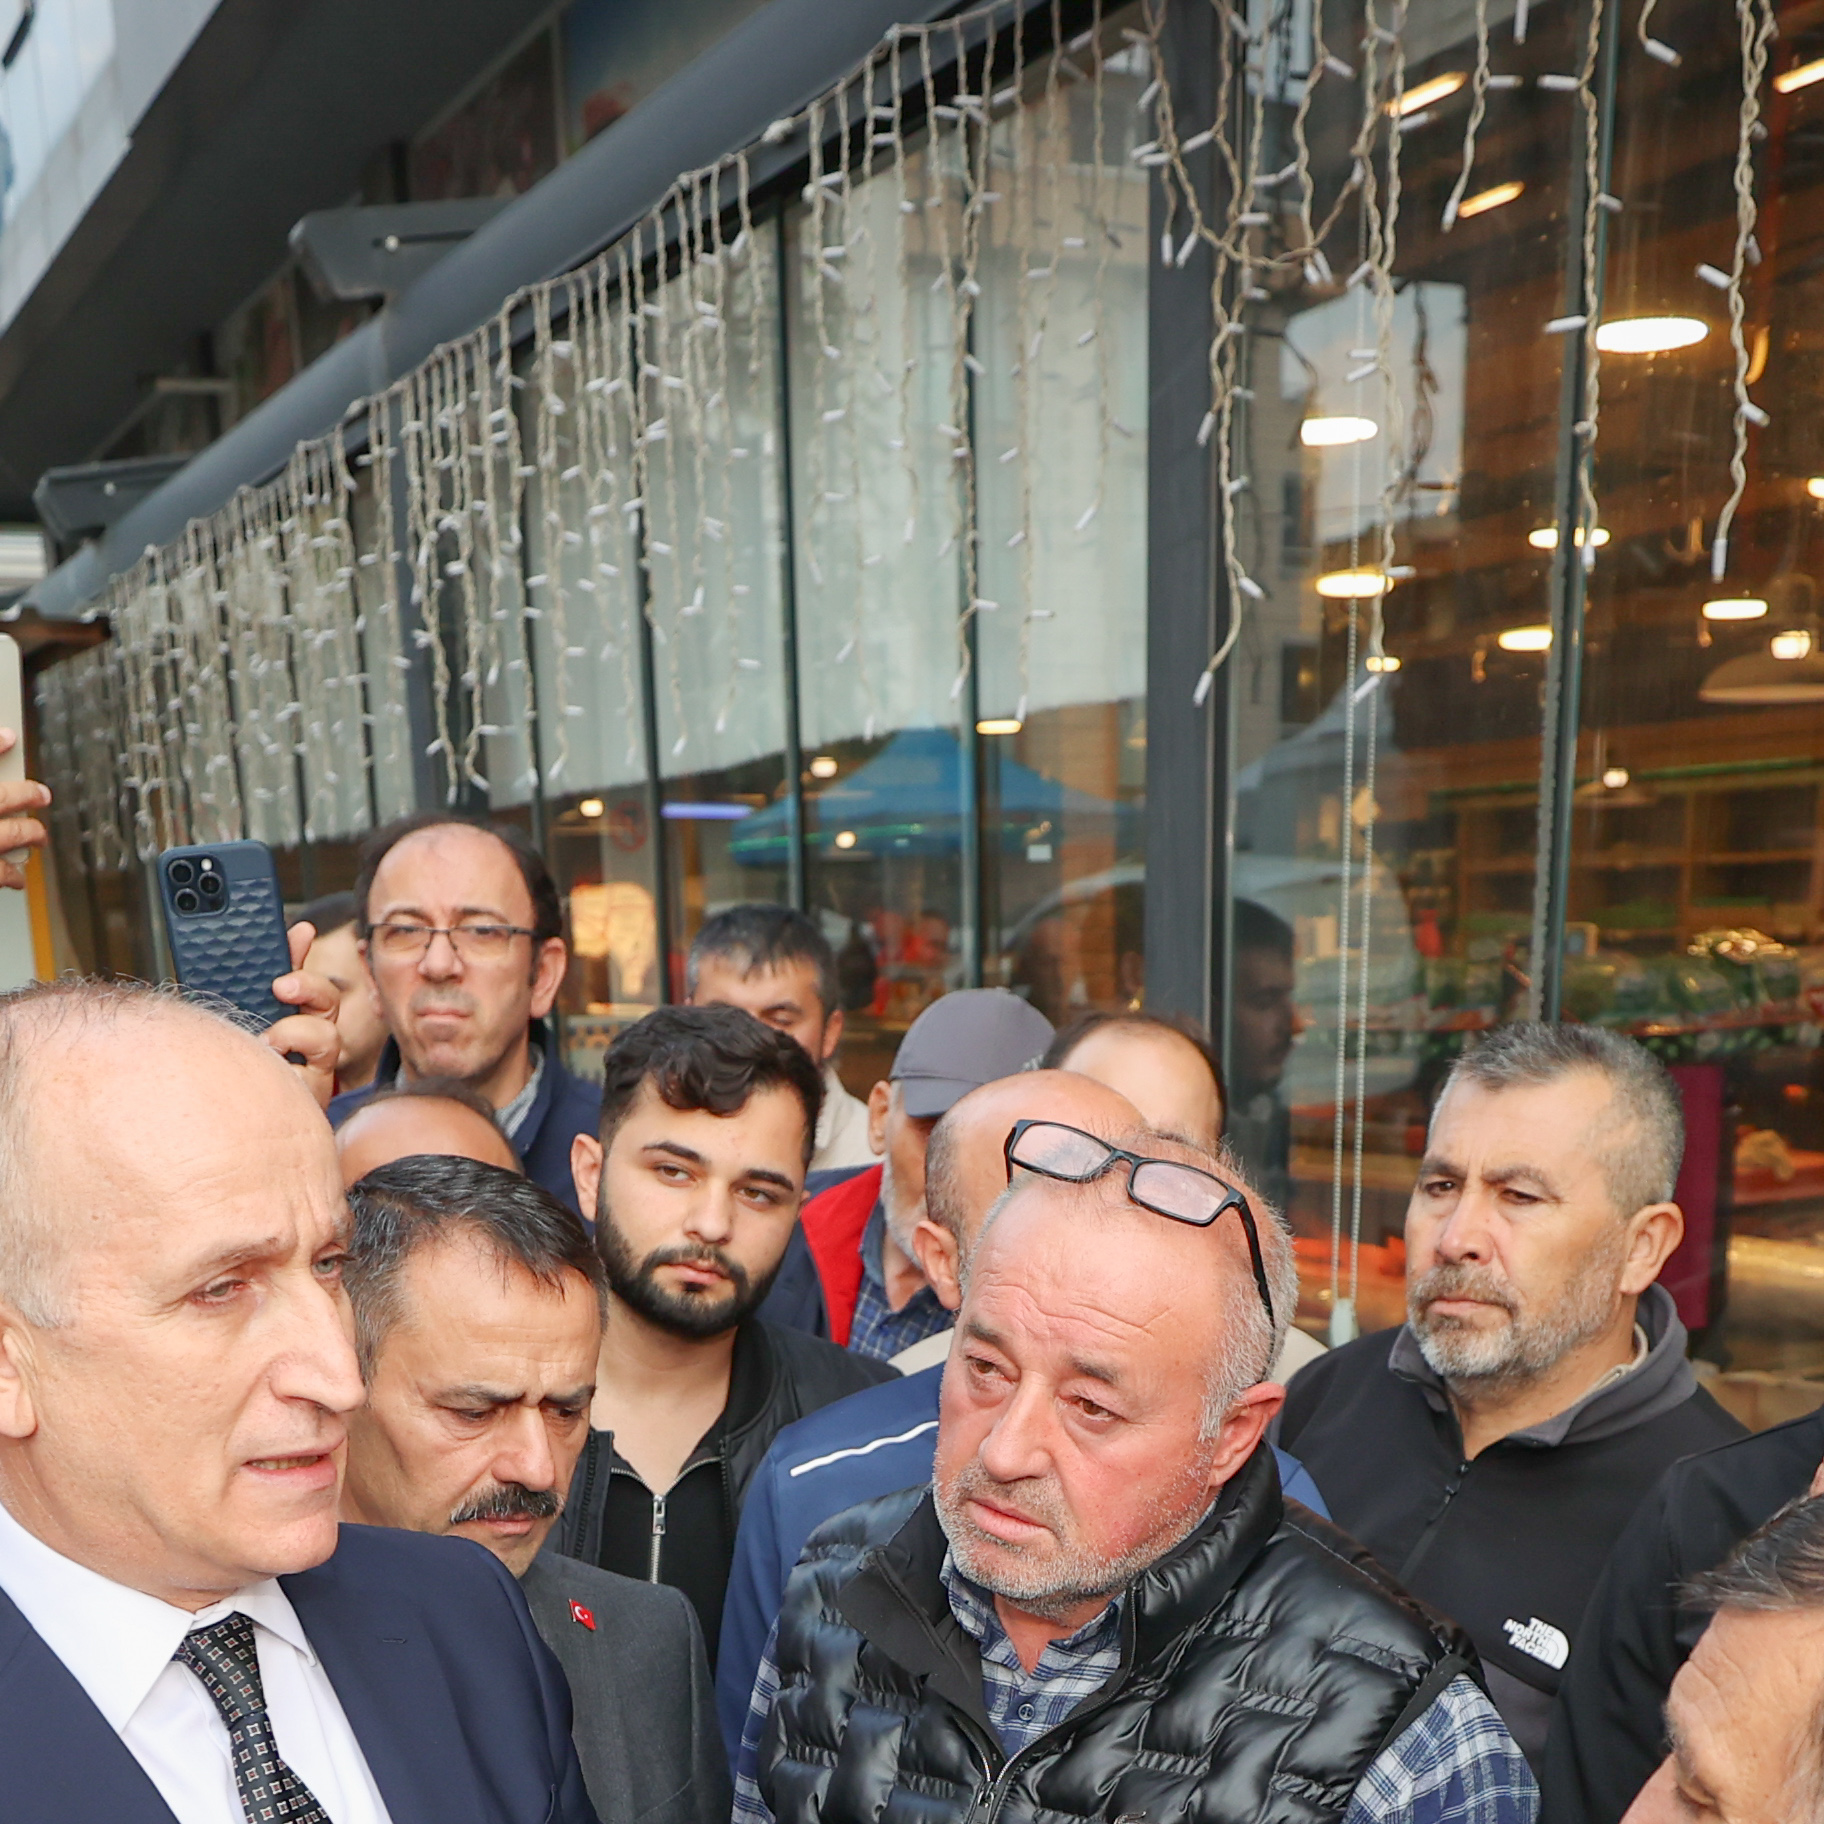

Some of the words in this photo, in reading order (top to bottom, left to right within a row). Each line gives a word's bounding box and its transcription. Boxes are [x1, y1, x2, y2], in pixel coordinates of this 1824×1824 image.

[1502, 1618, 1549, 1648] NORTH
[1528, 1616, 1555, 1638] THE
[1508, 1633, 1546, 1658] FACE
